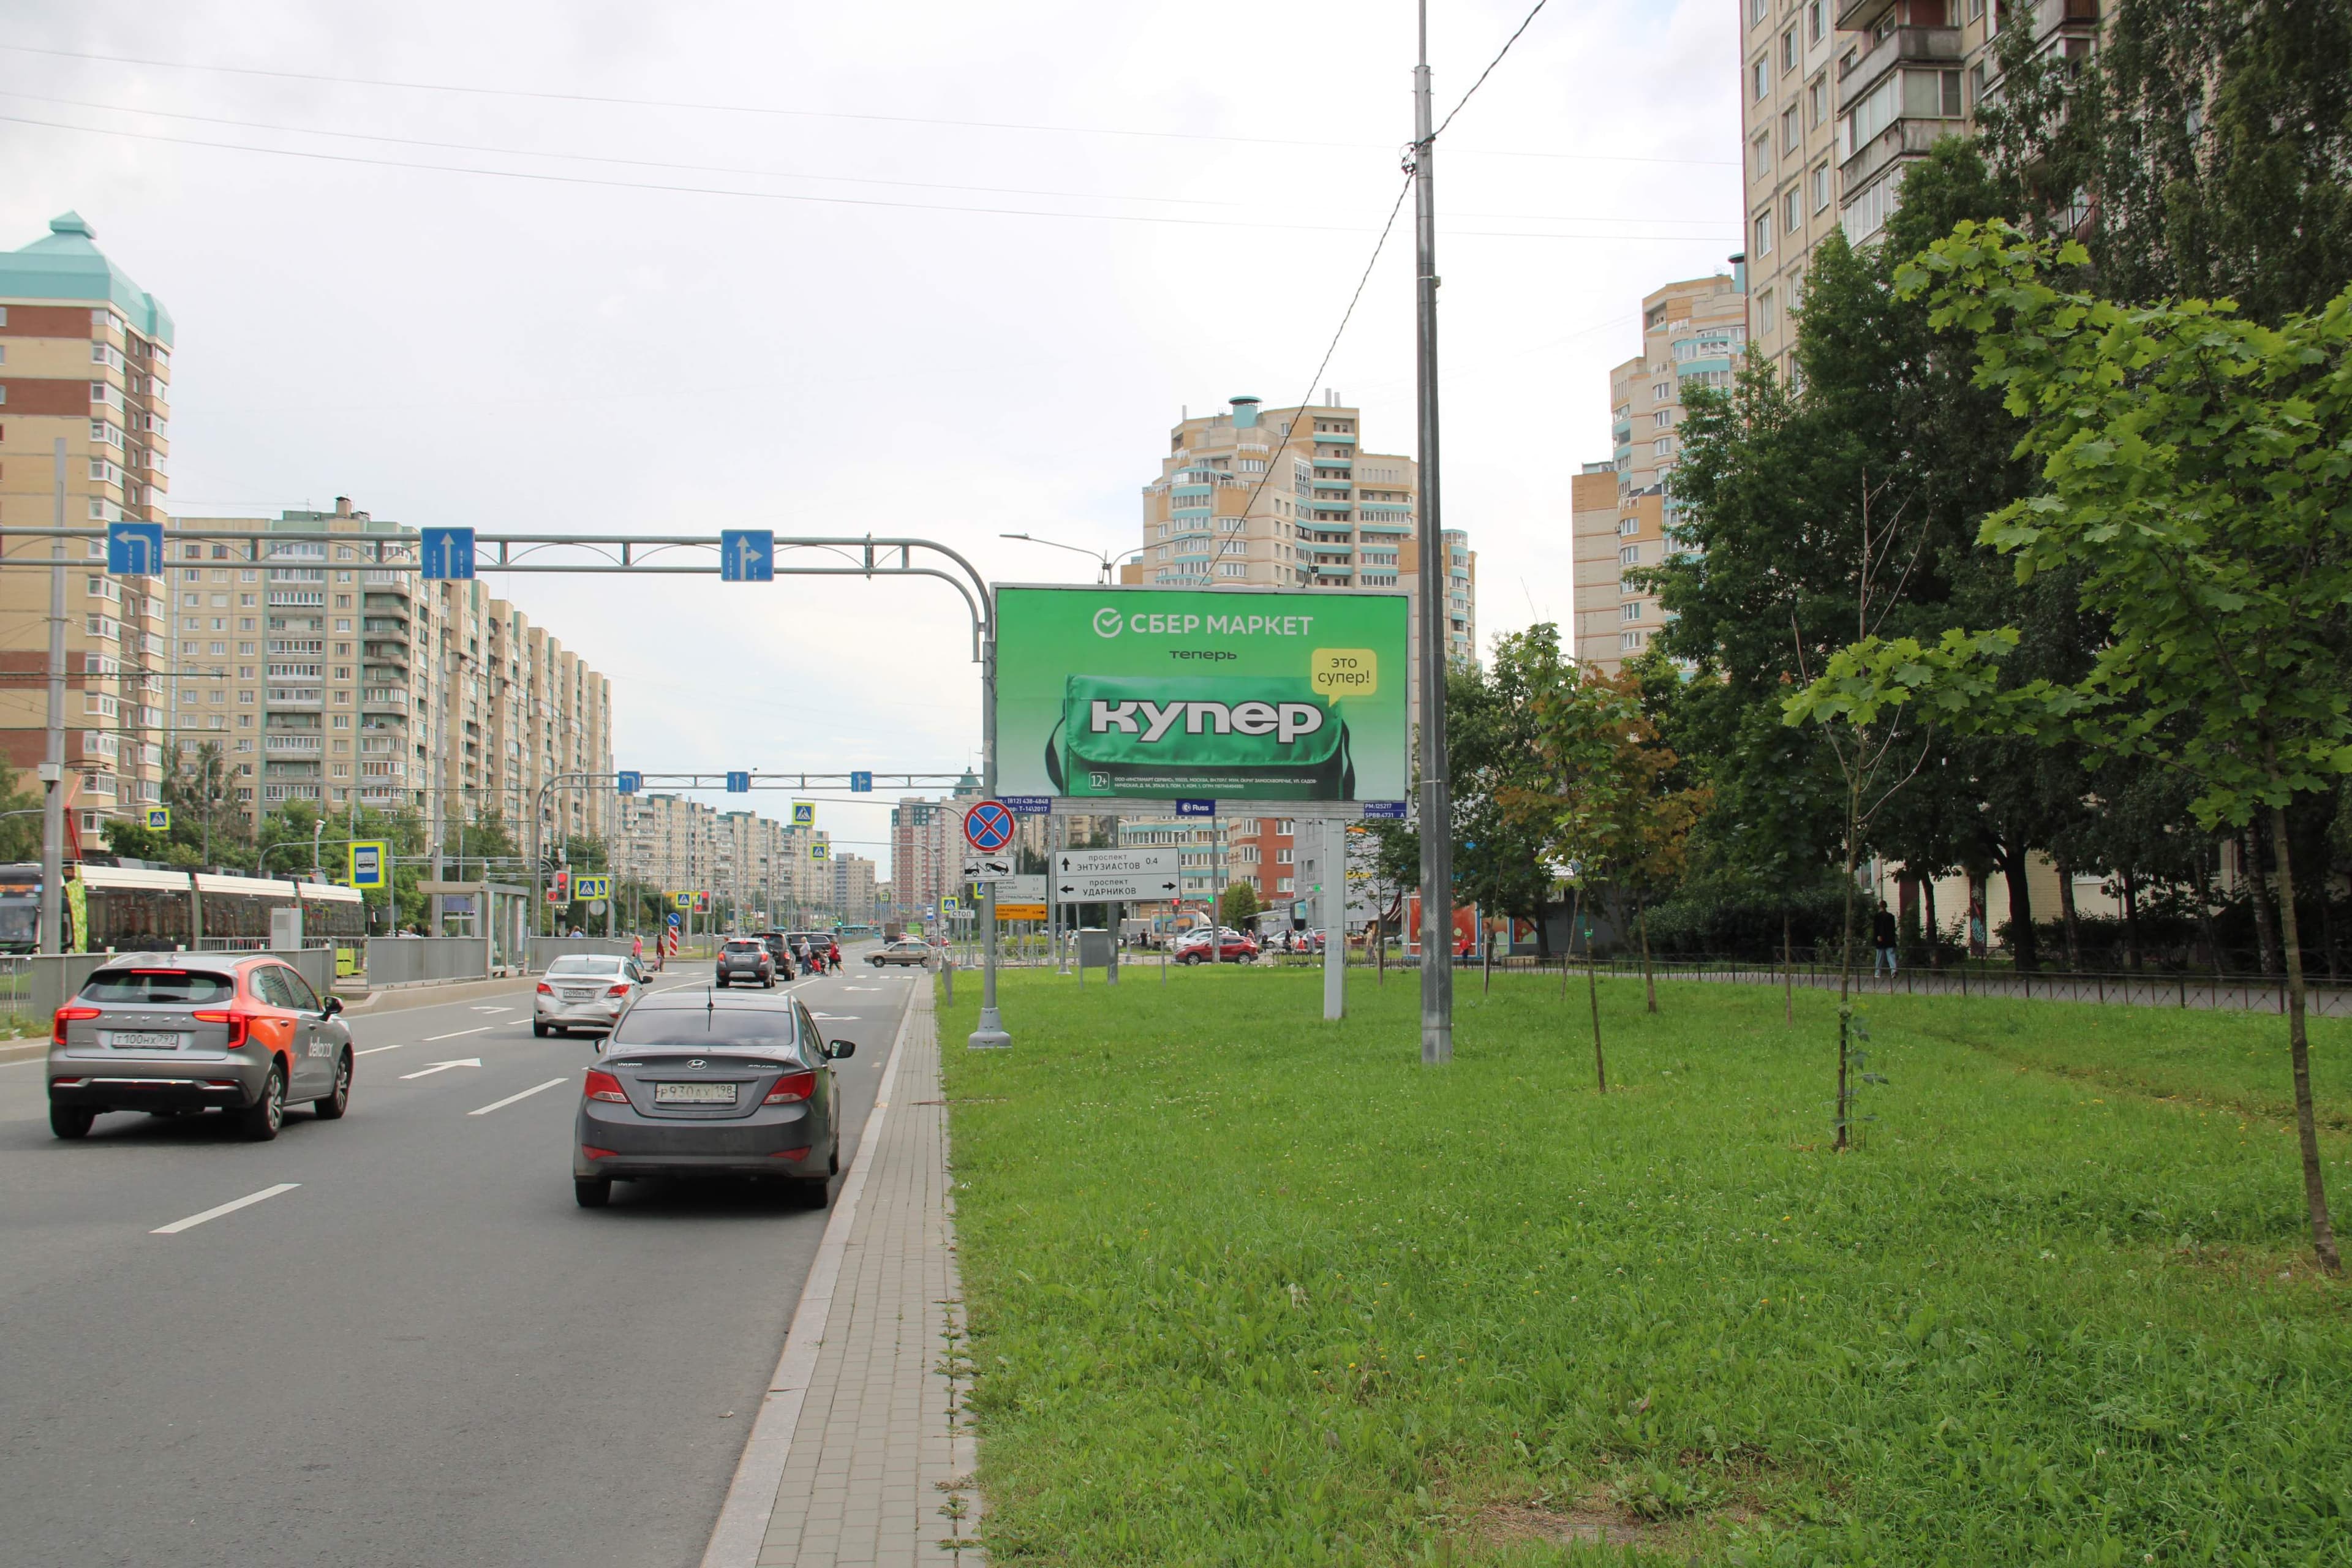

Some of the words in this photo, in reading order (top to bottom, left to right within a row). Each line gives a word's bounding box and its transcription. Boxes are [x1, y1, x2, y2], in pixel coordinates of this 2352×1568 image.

[1130, 614, 1200, 634] СБЕР
[1207, 615, 1314, 636] МАРКЕТ
[1169, 650, 1237, 662] теперь
[1331, 658, 1357, 668] это
[1318, 670, 1370, 686] супер!
[1090, 699, 1323, 744] купер
[1091, 775, 1107, 787] 12+
[1077, 862, 1140, 872] ЭНТУЗИАСТОВ
[1089, 879, 1128, 888] проспект
[1082, 888, 1137, 897] УДАРНИКОВ
